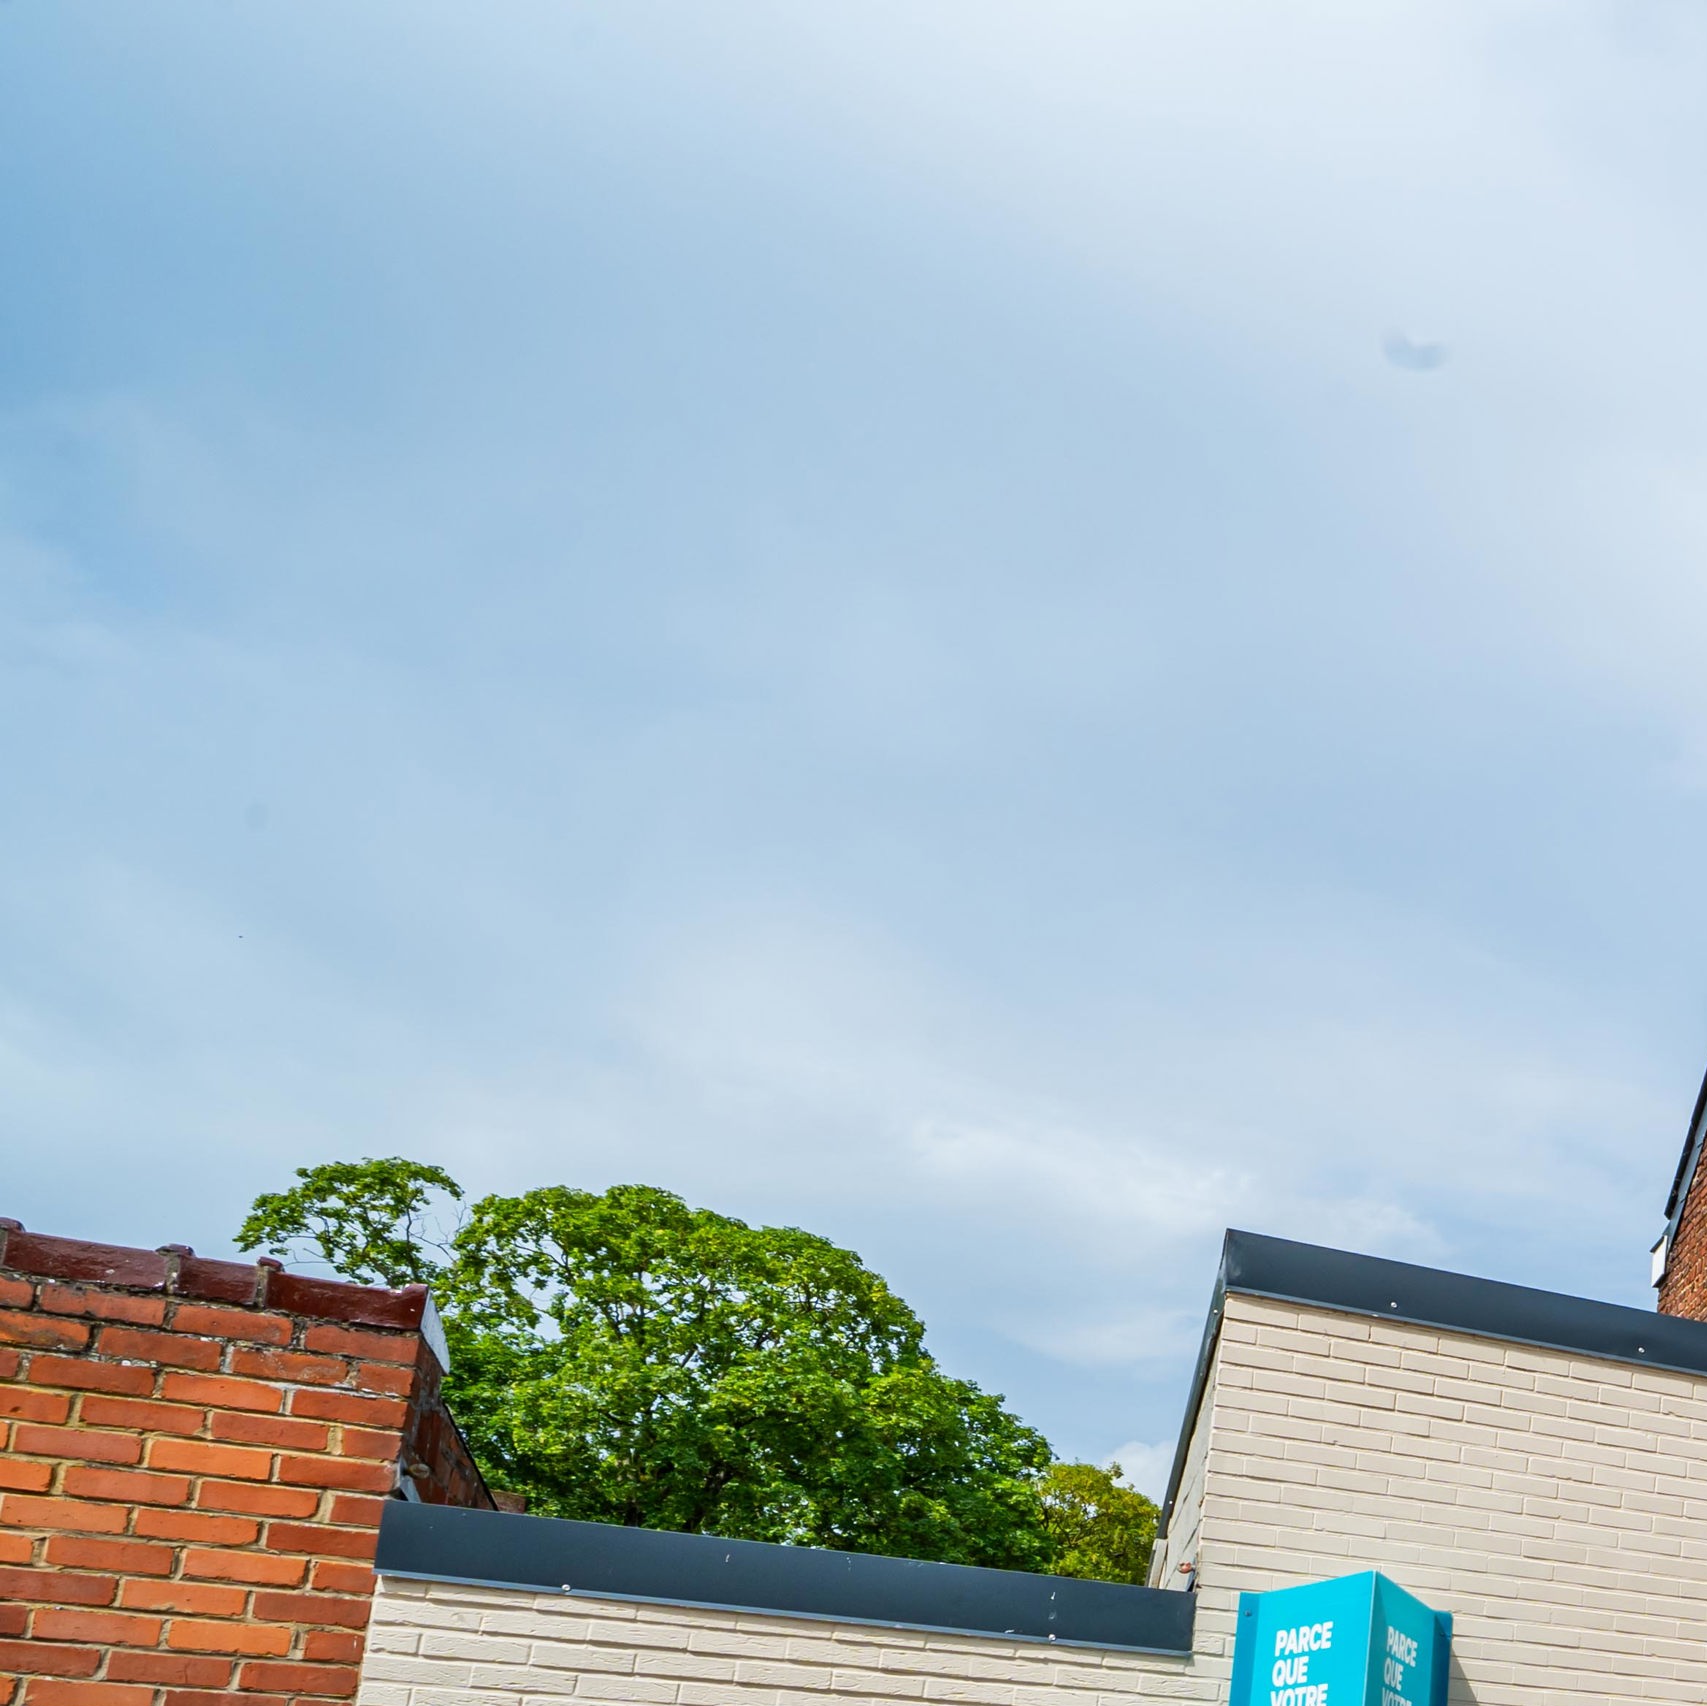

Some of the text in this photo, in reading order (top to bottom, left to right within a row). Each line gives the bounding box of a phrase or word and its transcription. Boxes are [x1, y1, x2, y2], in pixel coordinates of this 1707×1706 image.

[1274, 1621, 1334, 1657] PARCE
[1386, 1625, 1418, 1668] PARCE
[1272, 1656, 1309, 1688] QUE
[1383, 1657, 1404, 1691] QUE
